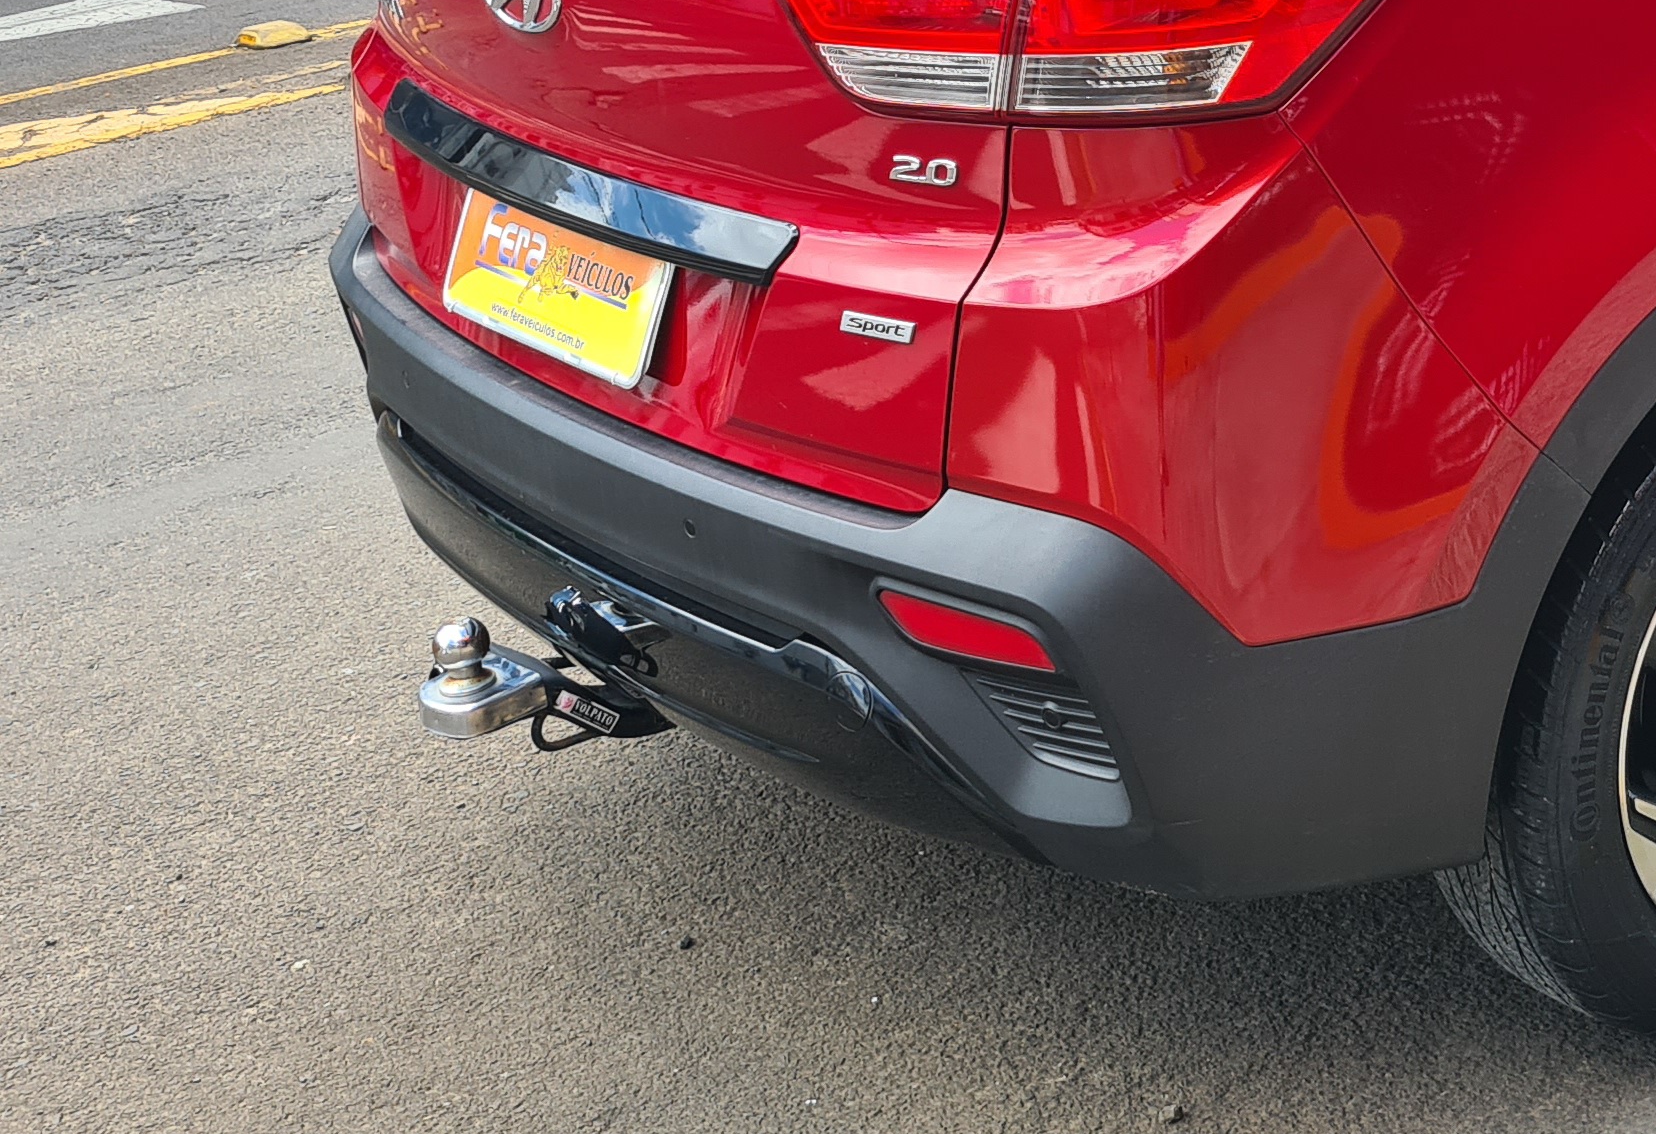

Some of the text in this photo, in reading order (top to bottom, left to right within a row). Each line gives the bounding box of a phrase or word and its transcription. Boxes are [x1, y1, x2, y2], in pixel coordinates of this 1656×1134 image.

[567, 251, 634, 300] VEÍCULOS
[491, 302, 585, 350] www.feraveiculos.com.br
[846, 317, 906, 337] Sport
[575, 700, 614, 726] VOLPATO
